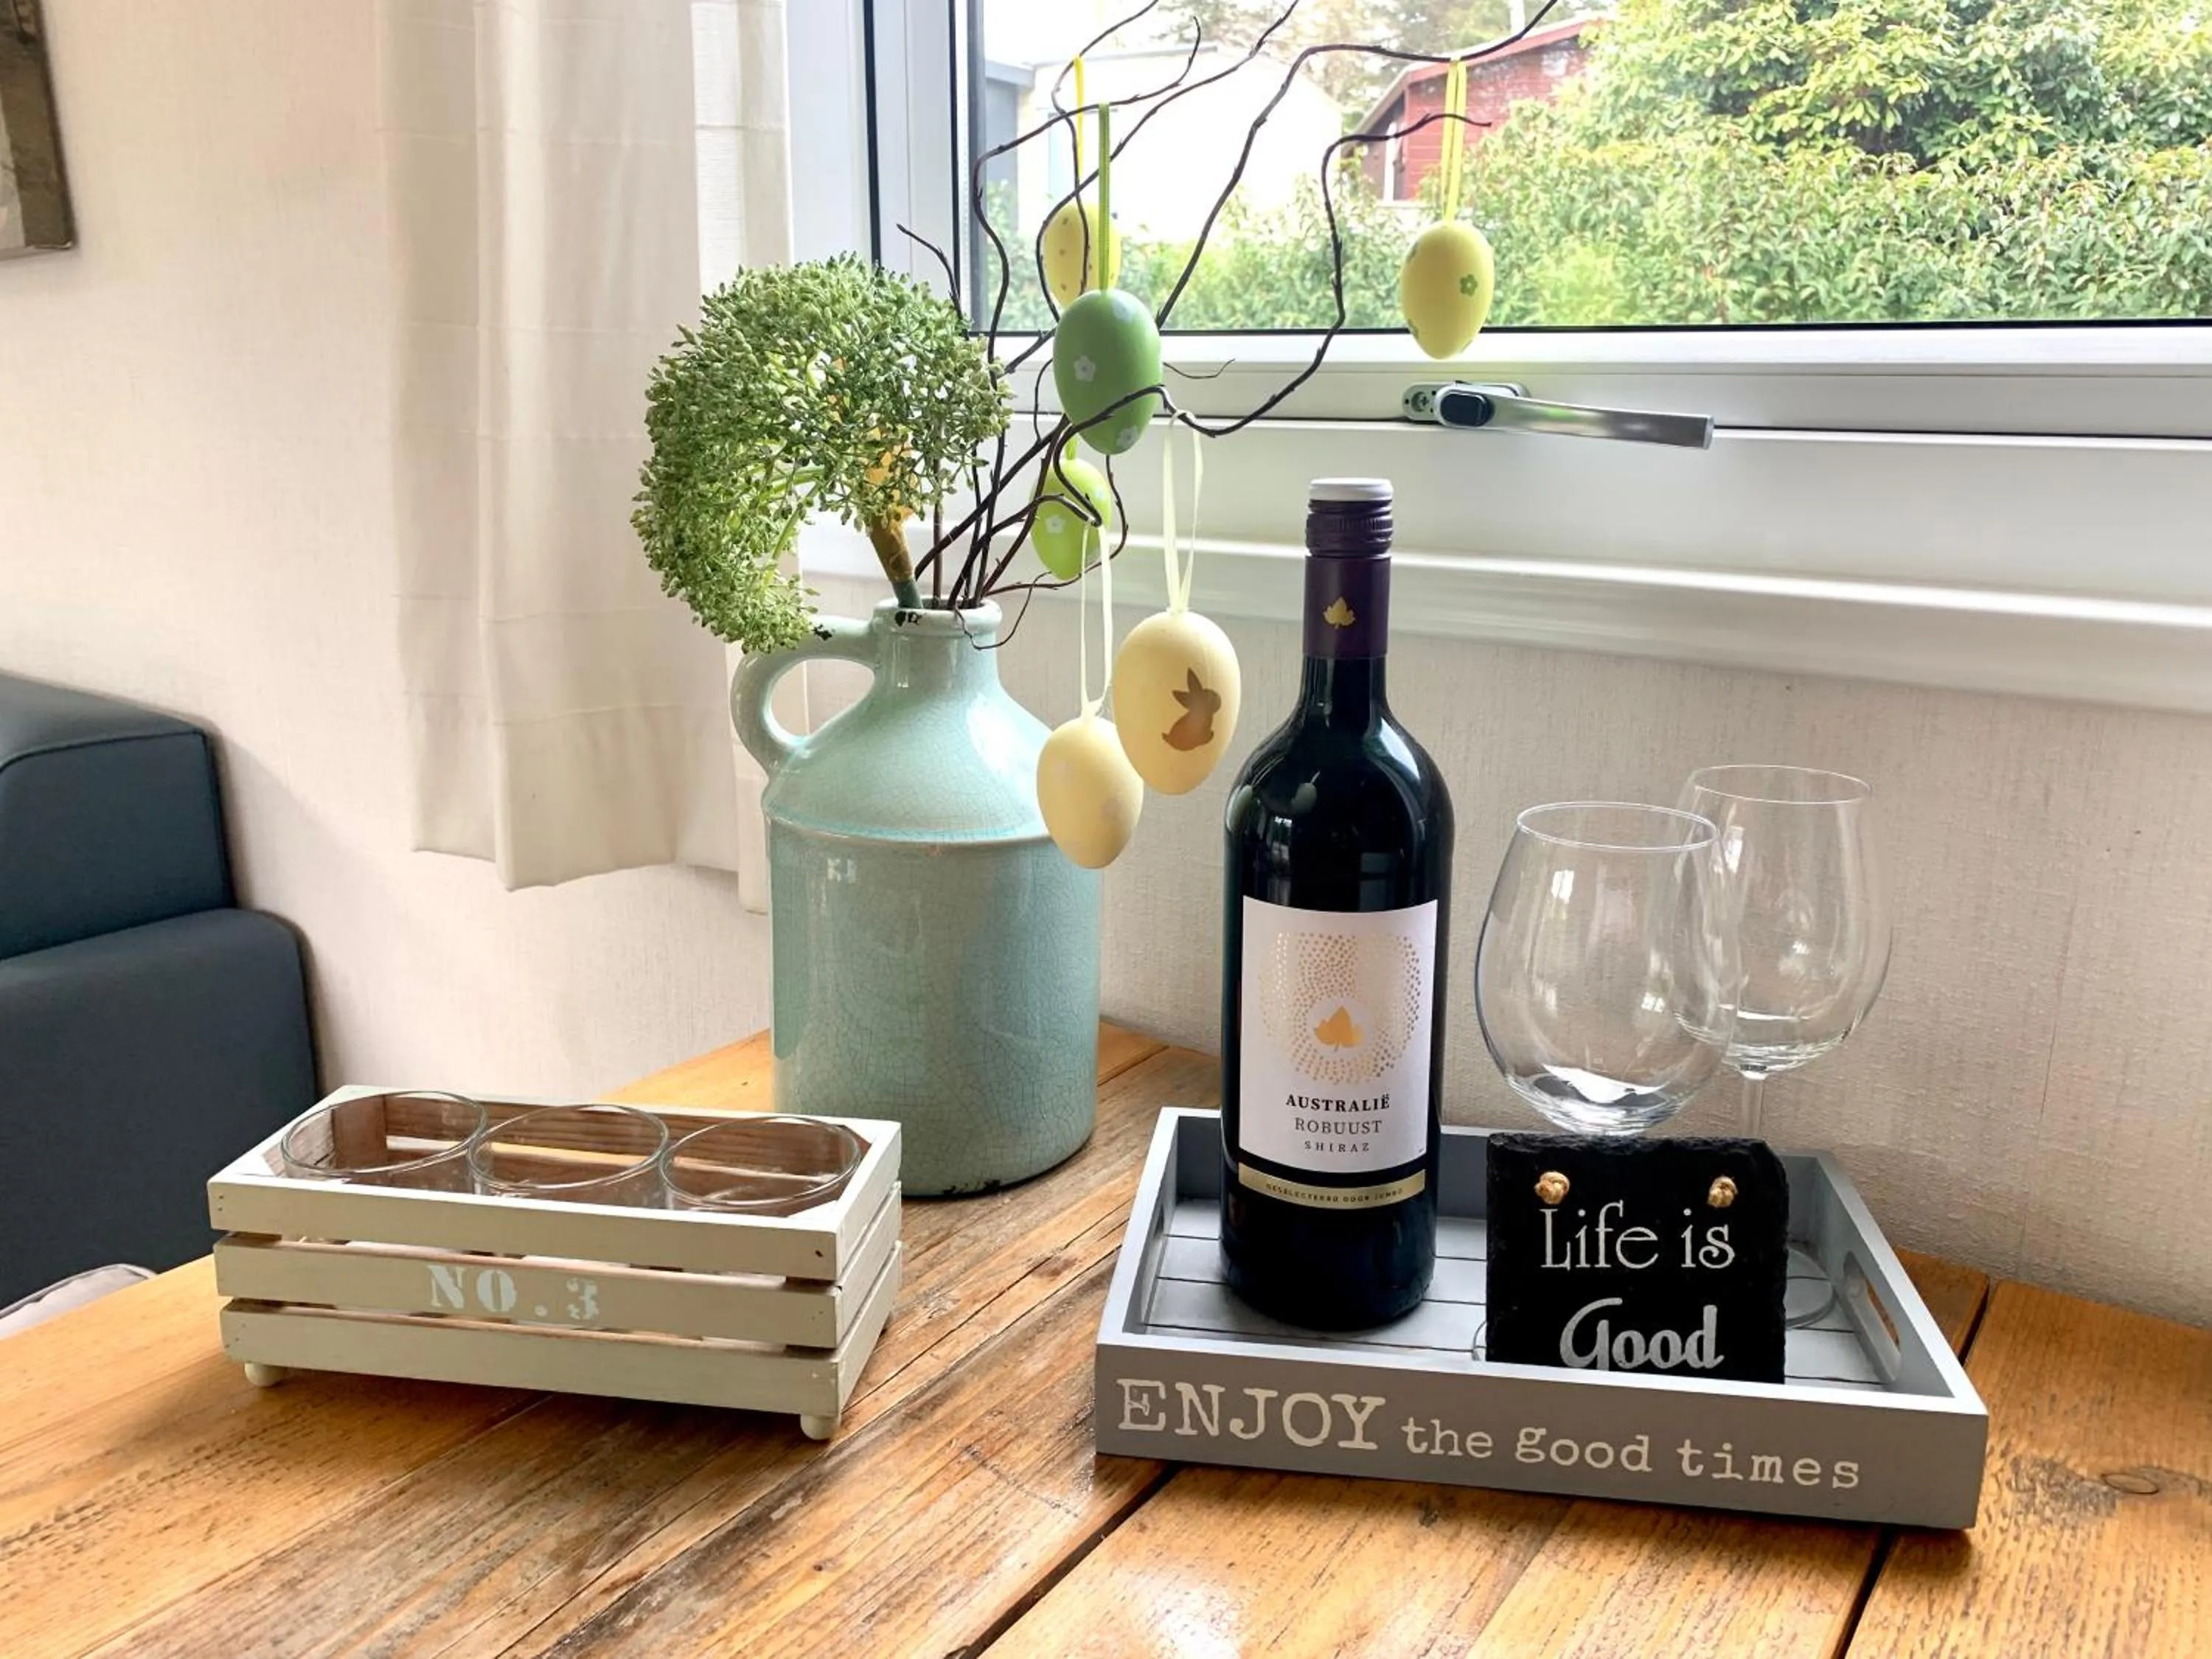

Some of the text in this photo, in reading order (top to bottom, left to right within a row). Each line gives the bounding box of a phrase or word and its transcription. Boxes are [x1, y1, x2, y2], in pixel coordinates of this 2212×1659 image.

[1286, 1094, 1391, 1113] AUSTRALIË
[1295, 1117, 1382, 1135] ROBUUST
[1304, 1141, 1369, 1152] SHIRAZ
[1540, 1200, 1735, 1270] Life is
[1559, 1297, 1725, 1371] Good
[1116, 1378, 1860, 1489] ENJOY the good times
